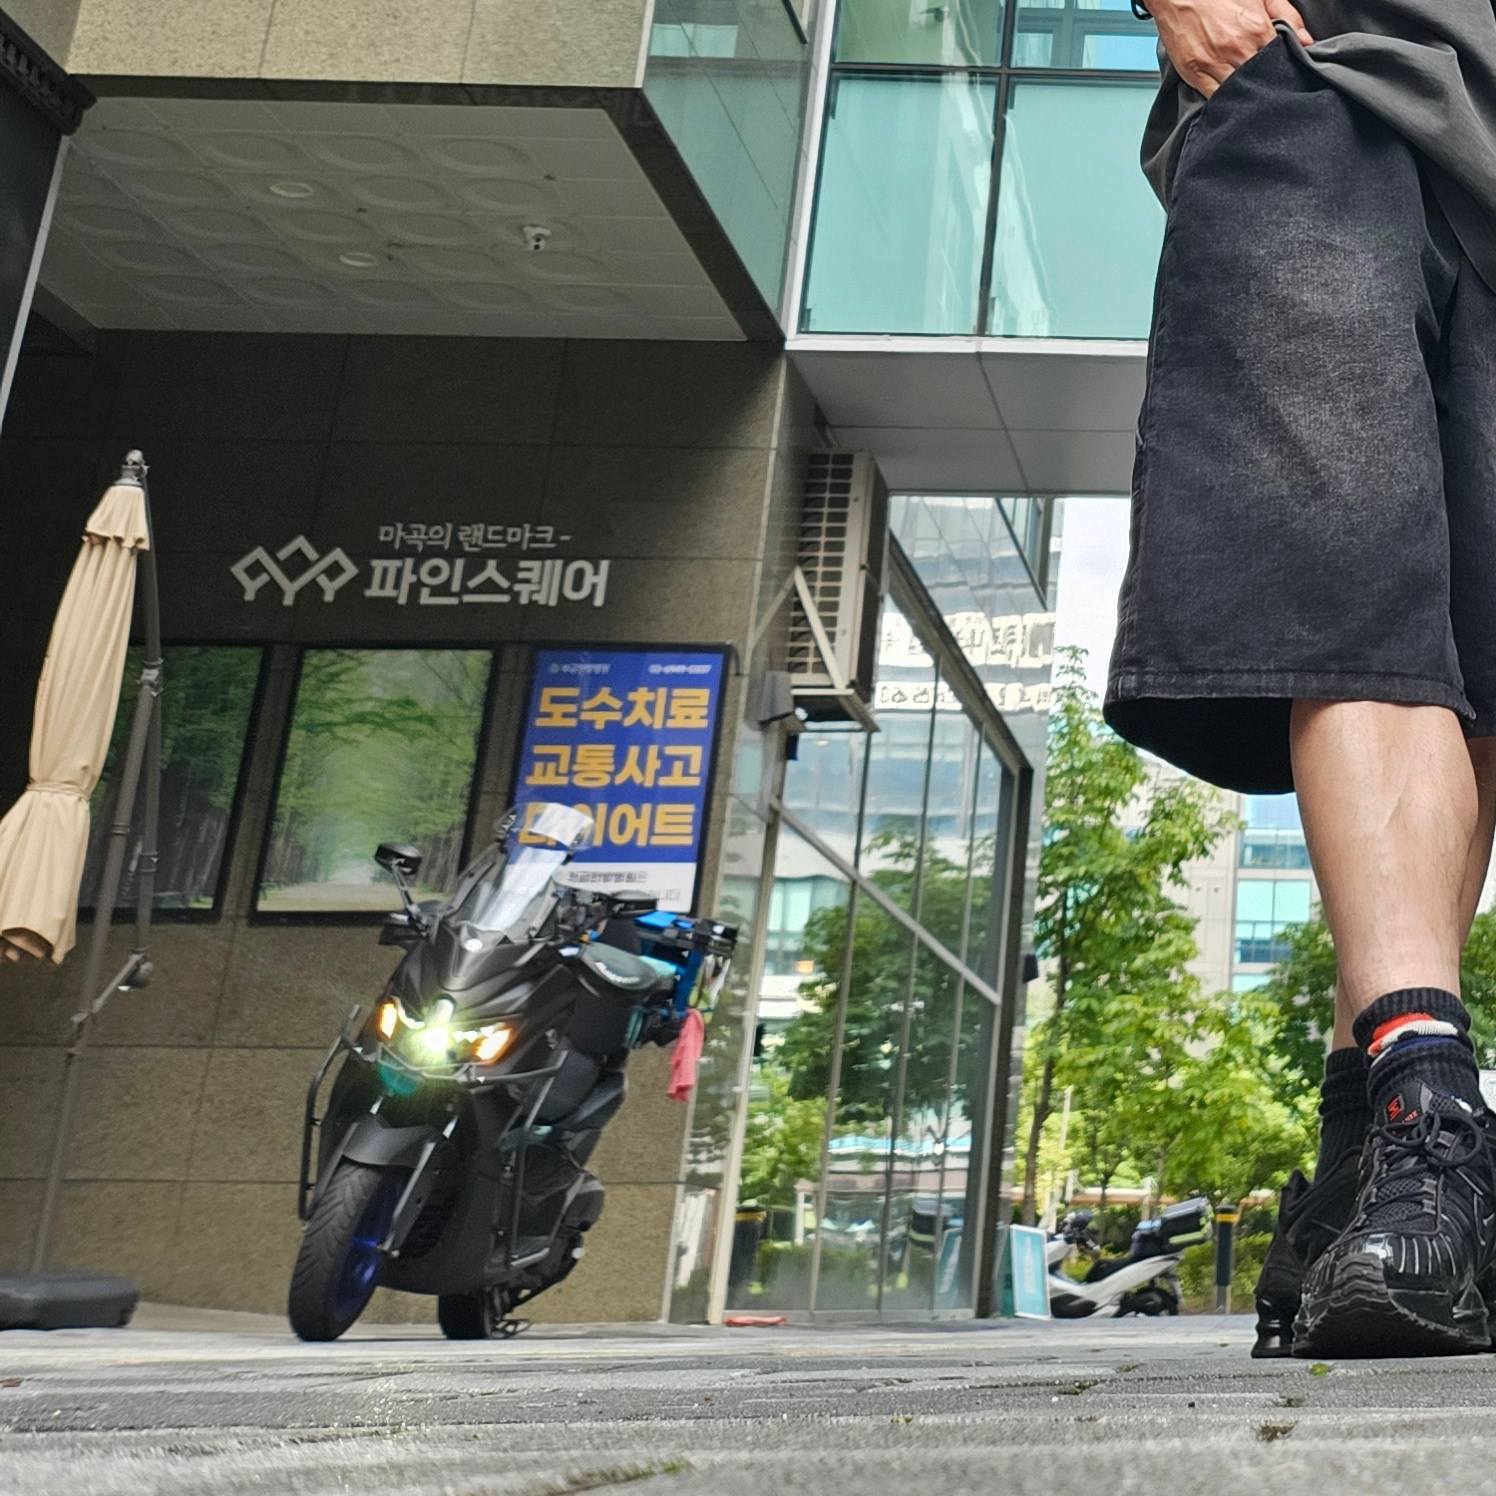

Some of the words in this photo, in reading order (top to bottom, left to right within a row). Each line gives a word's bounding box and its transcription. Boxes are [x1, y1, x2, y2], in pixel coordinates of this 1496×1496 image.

[379, 522, 451, 553] 마곡의
[363, 557, 611, 607] 파인스퀘어
[534, 686, 711, 730] 도수치료
[525, 743, 703, 789] 교통사고
